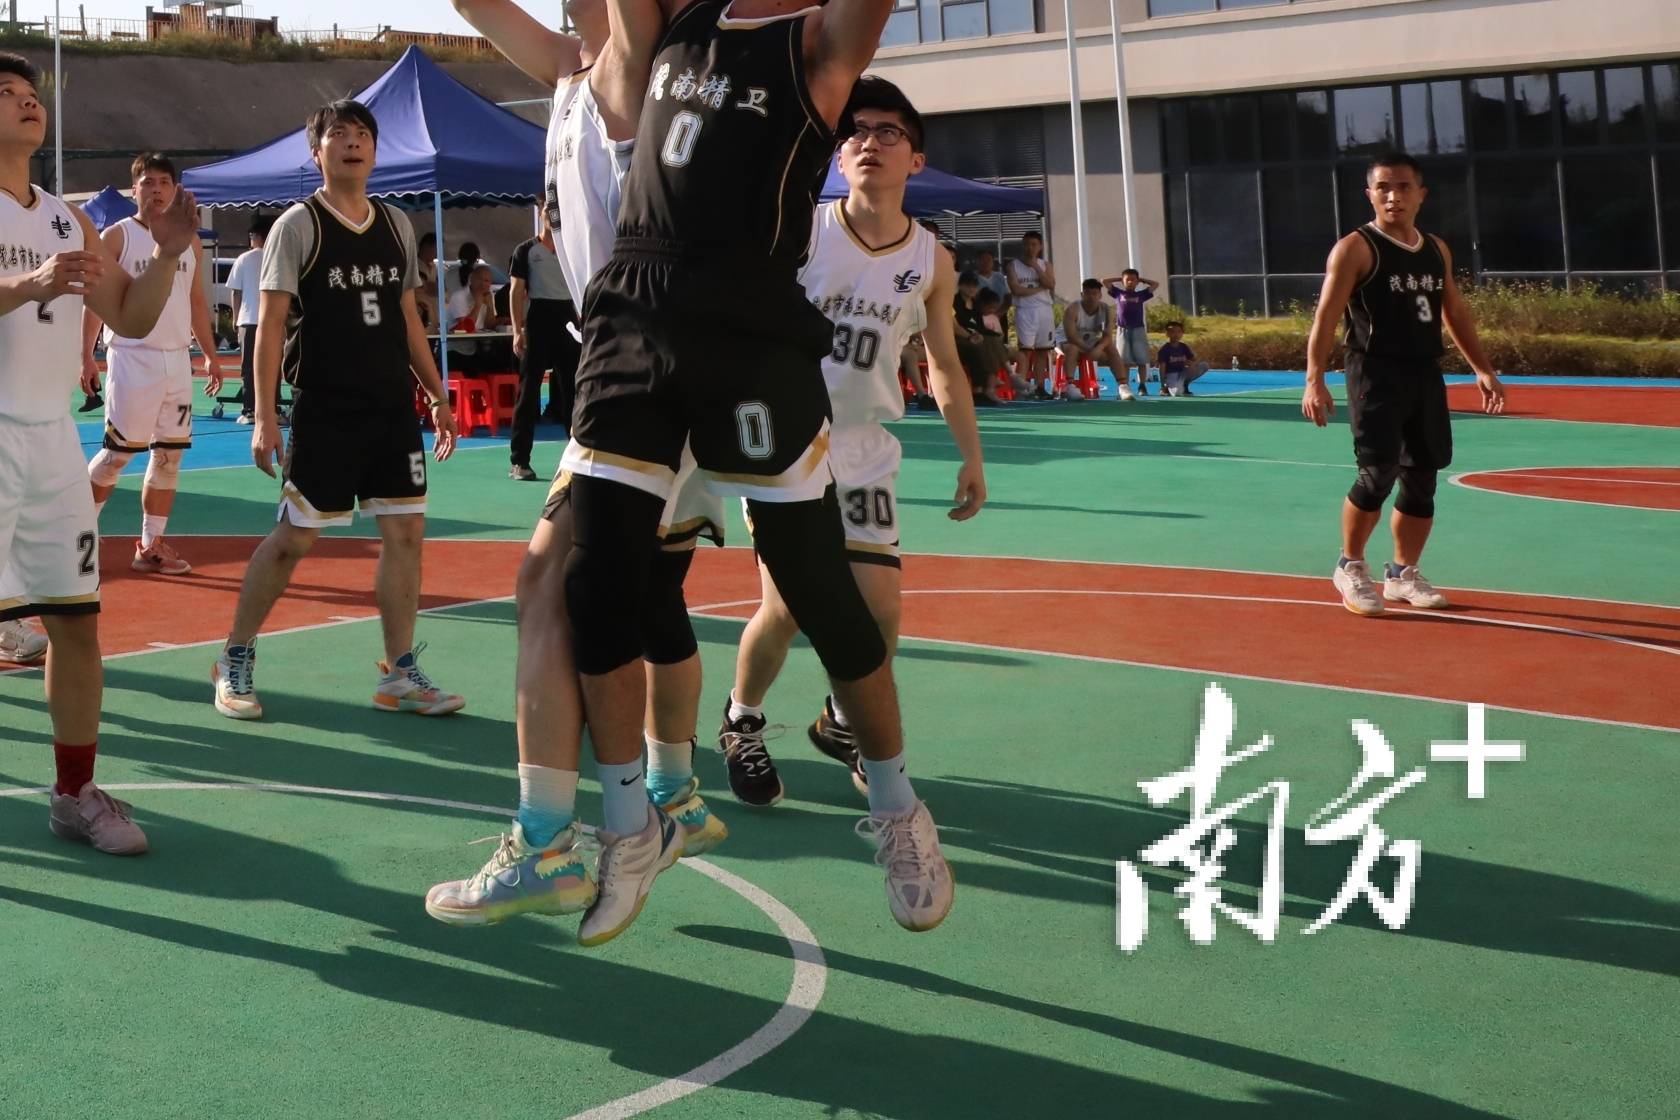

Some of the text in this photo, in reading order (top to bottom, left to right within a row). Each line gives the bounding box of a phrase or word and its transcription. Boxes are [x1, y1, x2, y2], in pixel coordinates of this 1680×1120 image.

[661, 110, 703, 168] 0
[328, 264, 400, 289] 茂南精卫
[360, 291, 381, 326] 5
[1415, 295, 1432, 322] 3
[831, 322, 881, 371] 30
[734, 400, 775, 460] 0
[408, 451, 425, 486] 5
[845, 486, 894, 530] 30
[76, 529, 95, 577] 2
